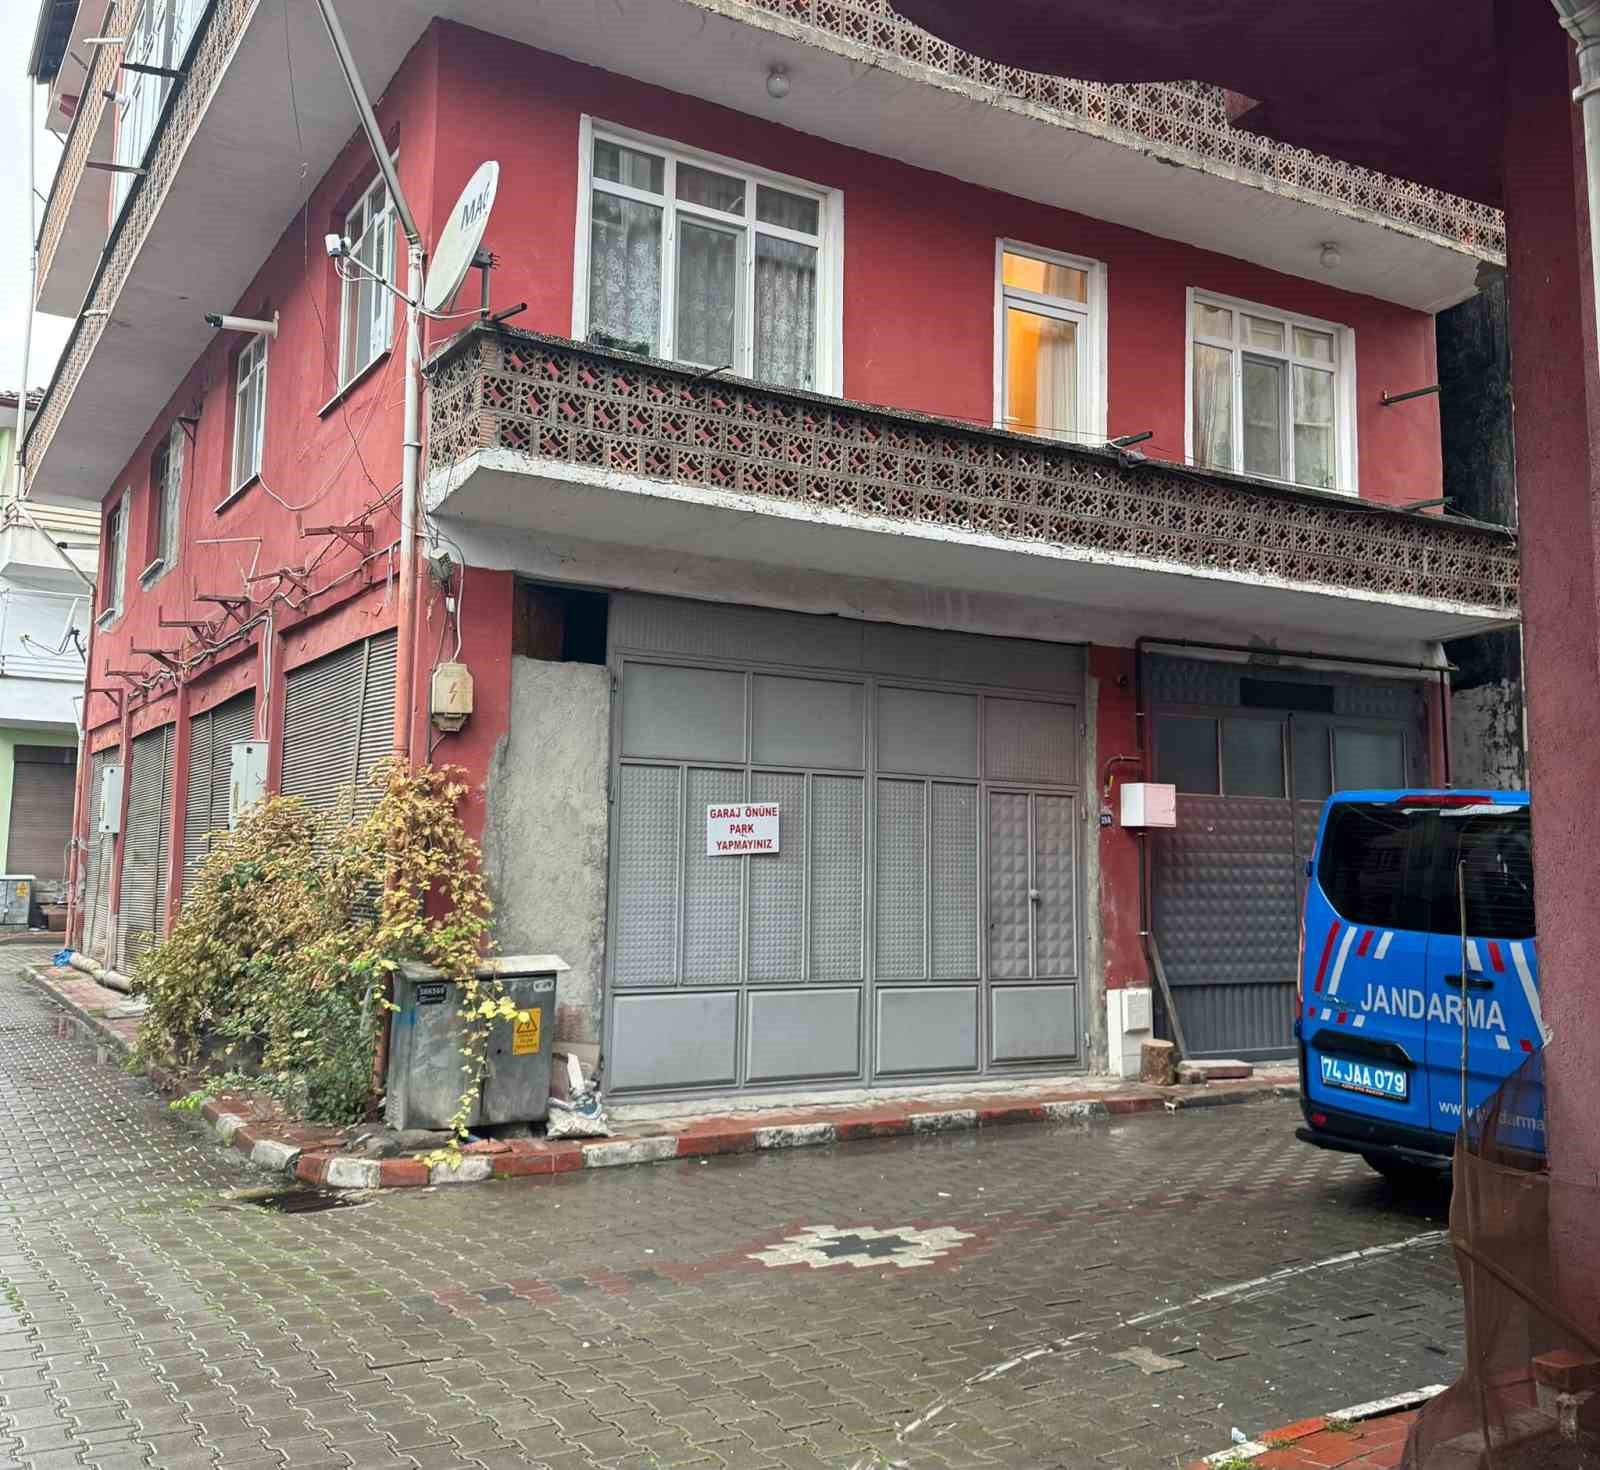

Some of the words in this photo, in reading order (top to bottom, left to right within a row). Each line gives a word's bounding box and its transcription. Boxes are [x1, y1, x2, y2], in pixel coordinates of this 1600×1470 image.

[710, 808, 741, 819] GARAJ
[745, 805, 778, 817] ÖNÜNE
[729, 823, 754, 834] PARK
[716, 839, 773, 851] YAPMAYINIZ
[1360, 983, 1507, 1032] JANDARMA
[1323, 1057, 1342, 1080] 74
[1344, 1063, 1372, 1087] JAA
[1374, 1069, 1405, 1093] 079
